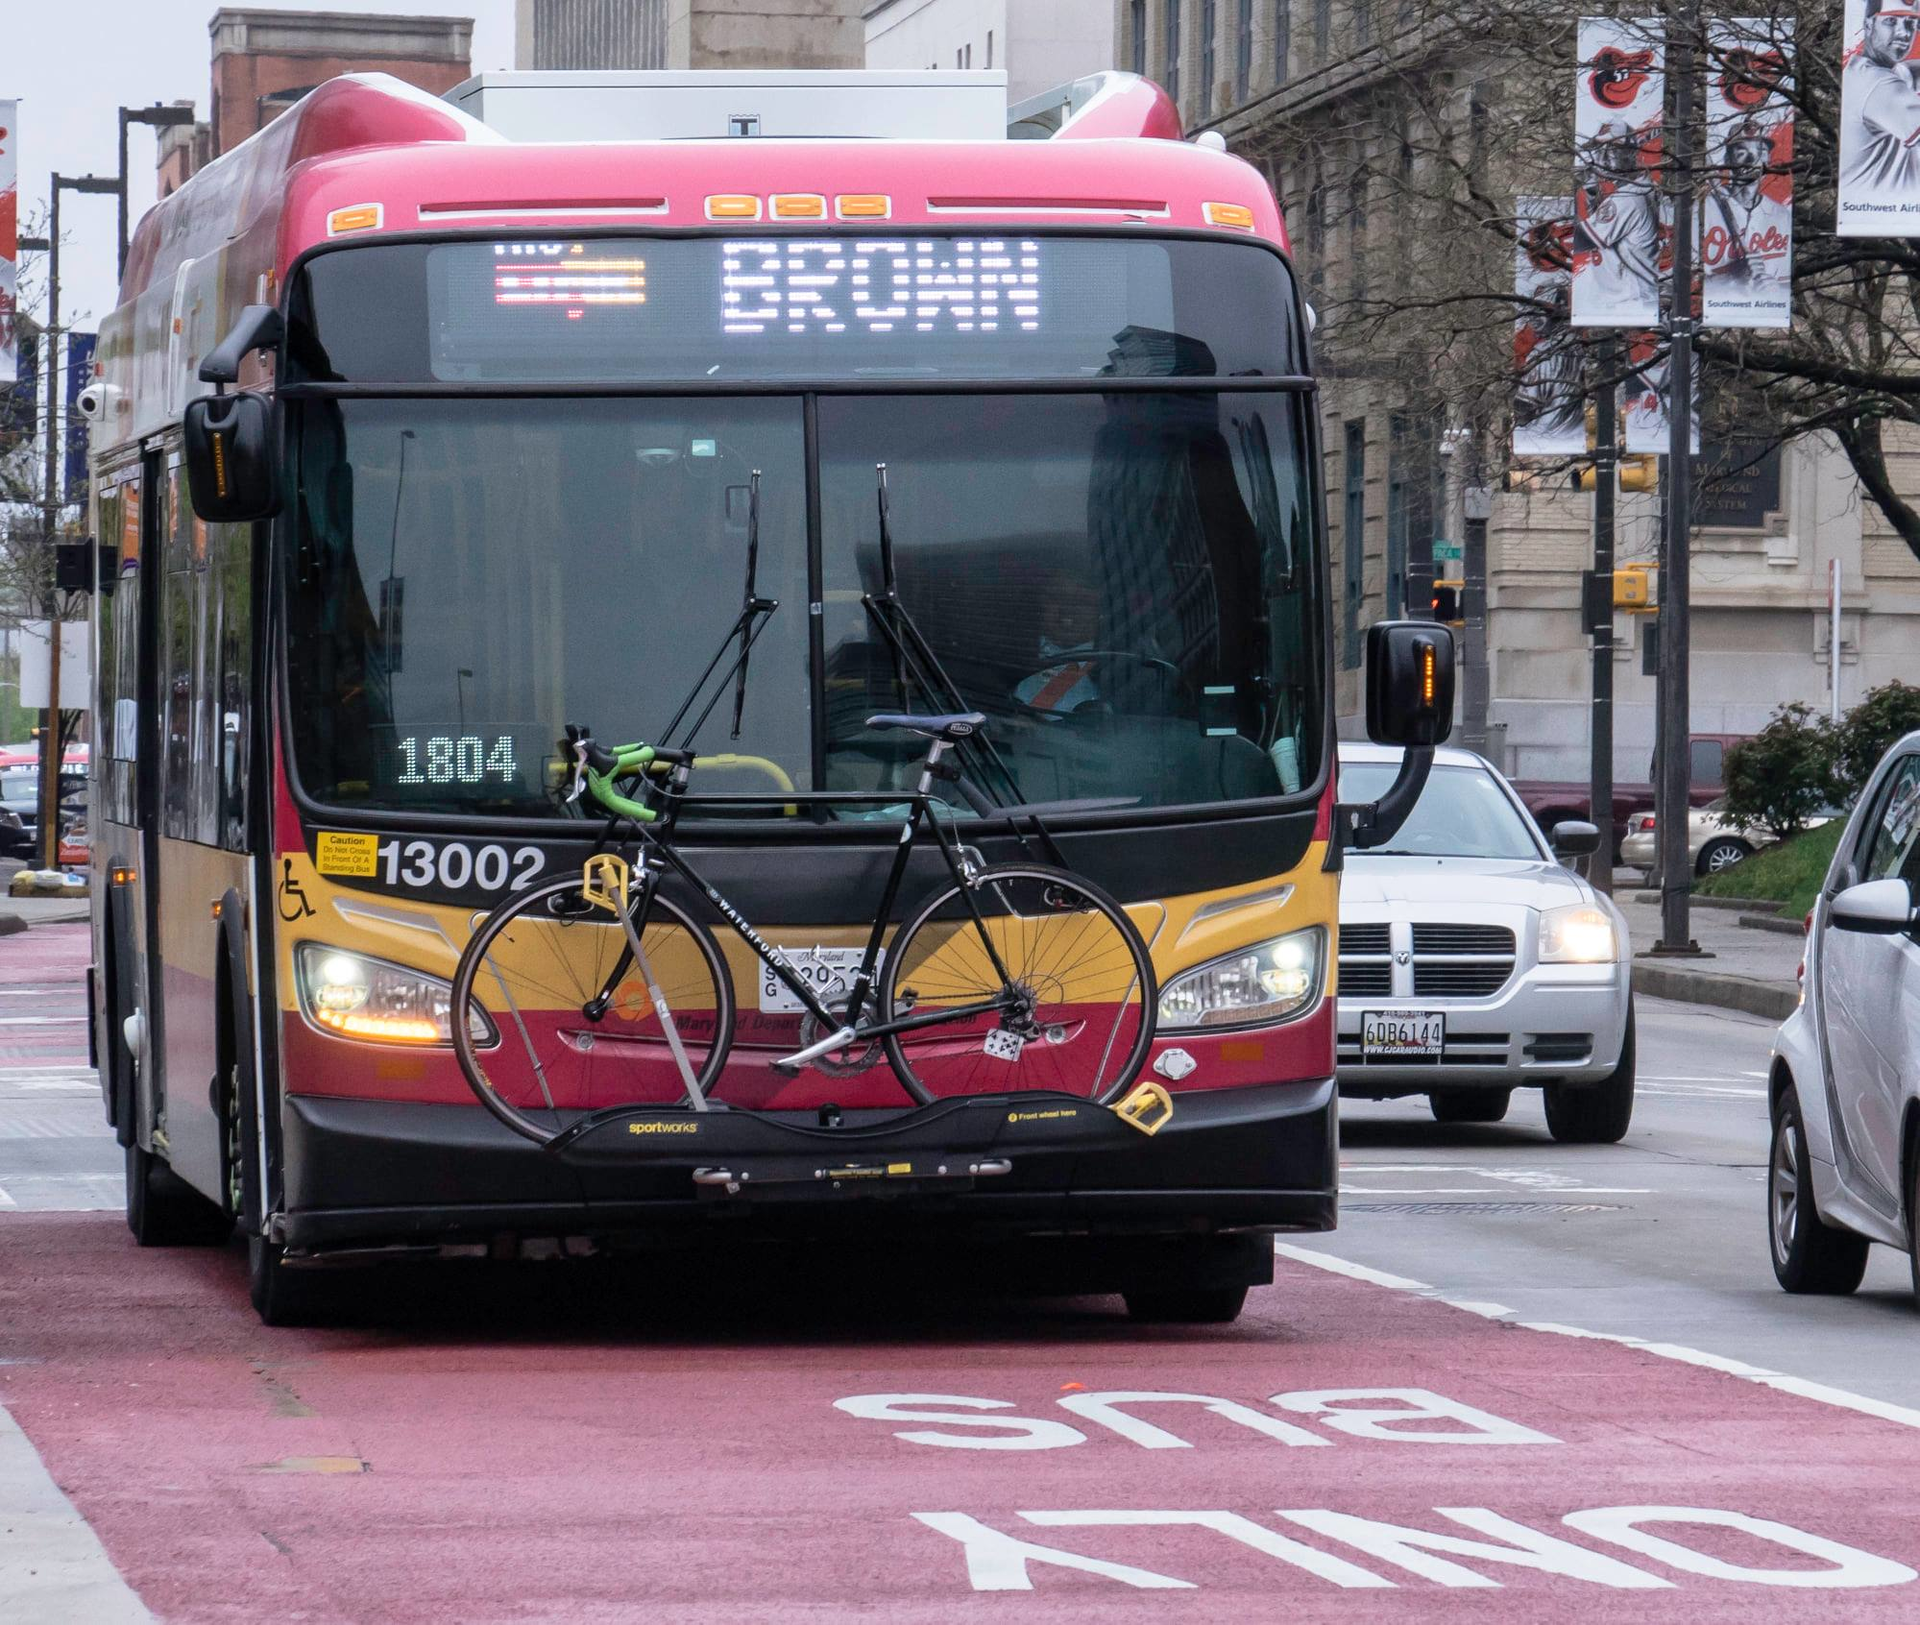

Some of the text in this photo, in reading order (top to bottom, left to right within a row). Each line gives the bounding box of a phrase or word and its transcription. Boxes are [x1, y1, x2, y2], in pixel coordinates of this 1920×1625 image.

[1842, 202, 1896, 213] Southwest
[723, 242, 1039, 332] BROWN
[1707, 300, 1786, 308] Southwest Airlines
[398, 736, 517, 783] 1804
[330, 836, 366, 845] Caution
[378, 840, 546, 891] 13002
[719, 899, 783, 967] WATERFORD
[798, 952, 845, 962] Mryland
[676, 1014, 748, 1031] Marynd
[1366, 1022, 1440, 1042] 6DB6144
[1018, 1113, 1038, 1121] Front
[1039, 1111, 1059, 1119] wheel
[1060, 1109, 1077, 1117] here
[629, 1121, 697, 1135] sportworks
[836, 1388, 1564, 1450] BUS
[909, 1505, 1919, 1591] ONLY
